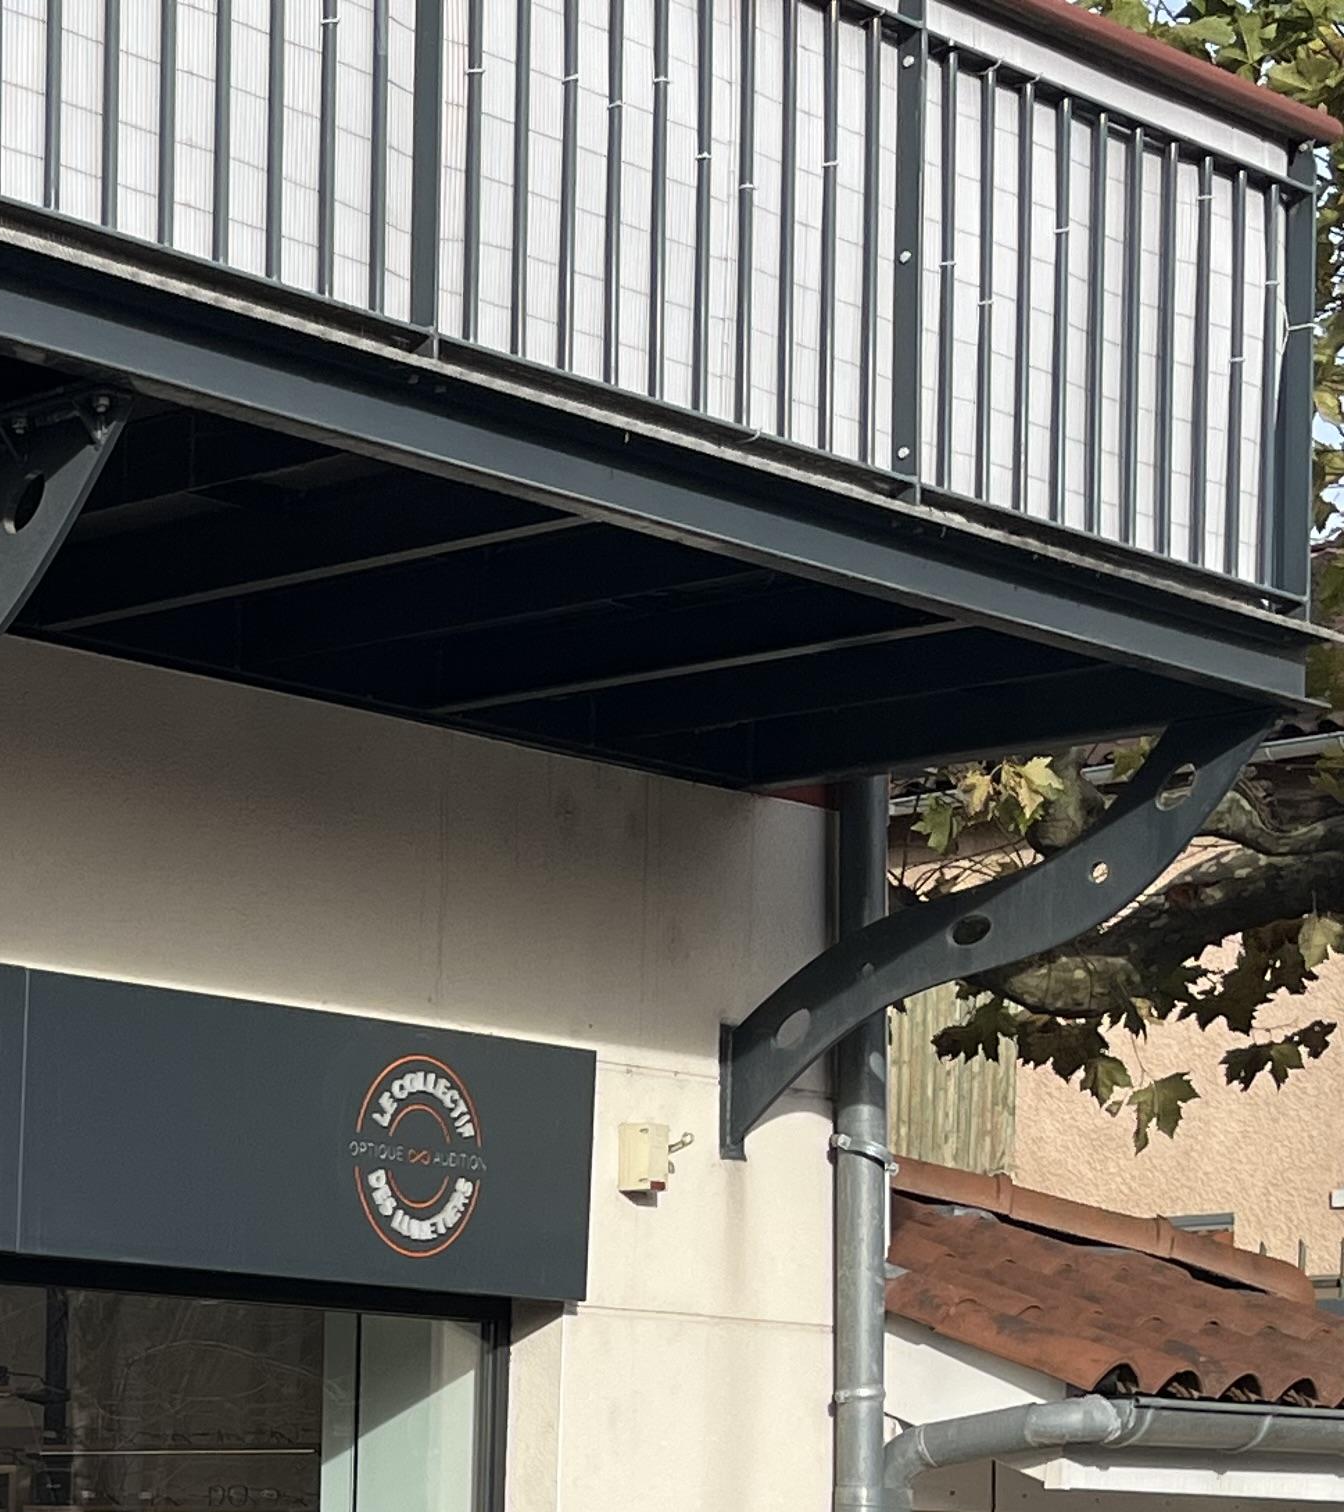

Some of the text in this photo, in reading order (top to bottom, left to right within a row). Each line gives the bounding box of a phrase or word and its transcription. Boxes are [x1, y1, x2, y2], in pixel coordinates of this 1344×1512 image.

[372, 1071, 475, 1138] LE COLLECTIF
[348, 1140, 487, 1172] OPTIQUE AUDITION
[367, 1168, 474, 1241] DES LUNETIERS
